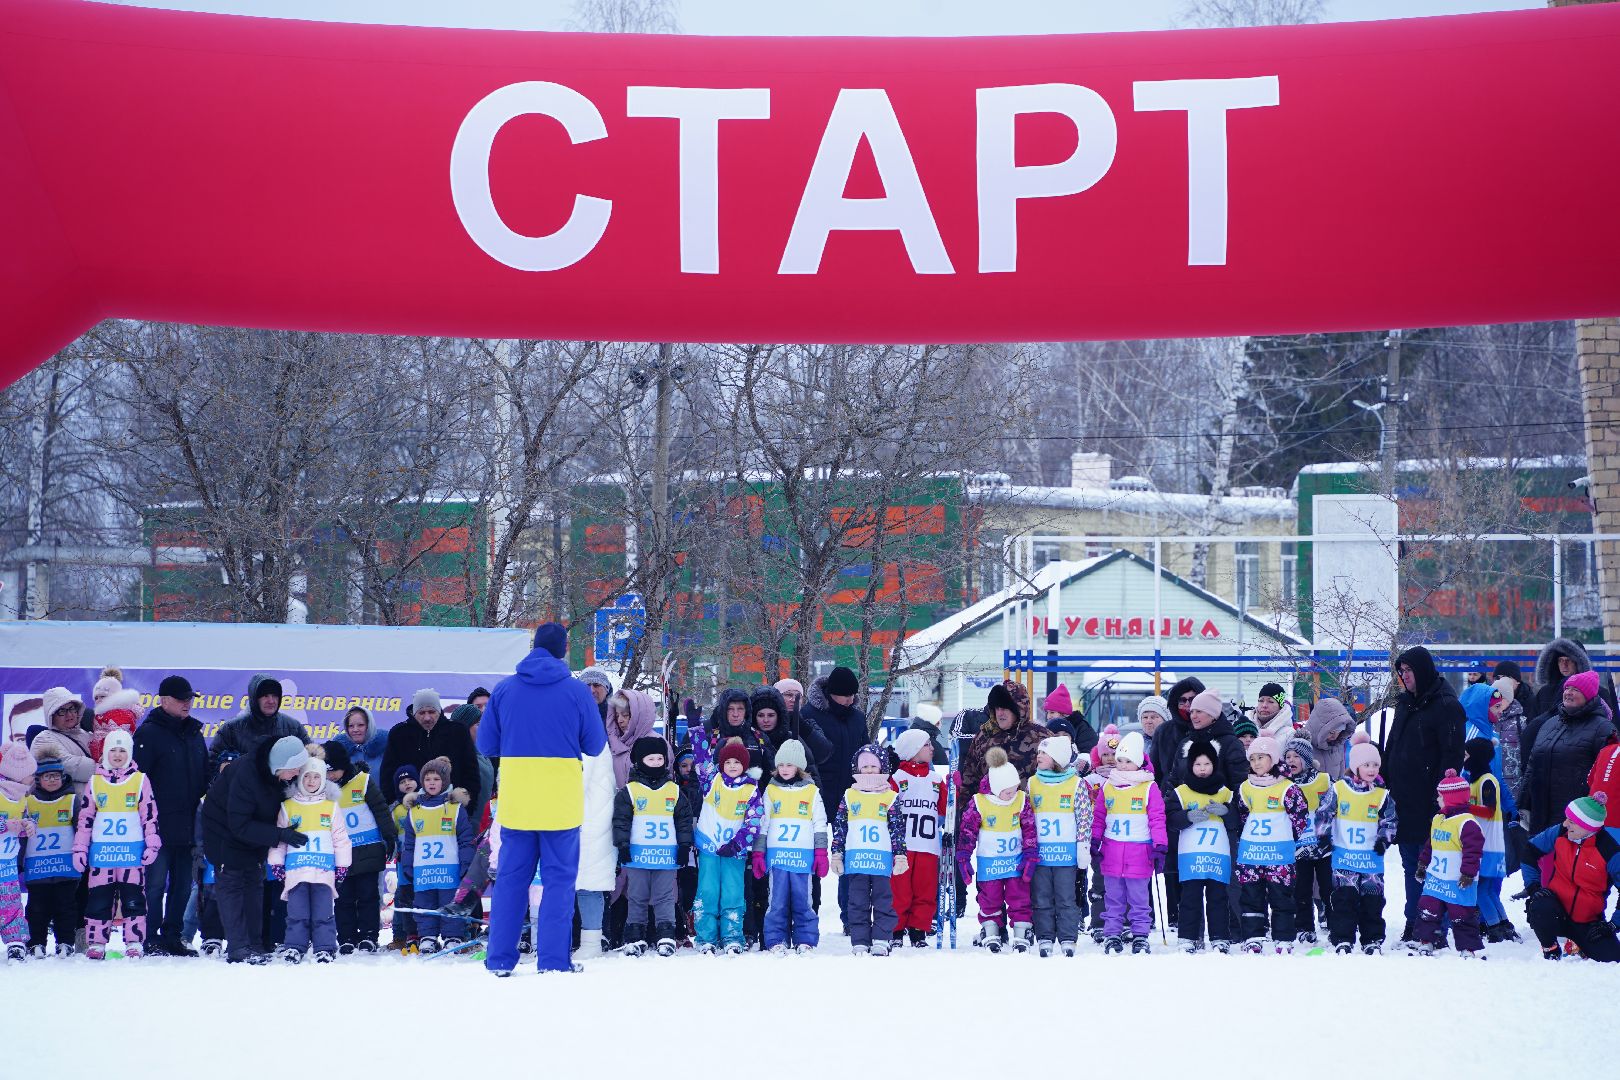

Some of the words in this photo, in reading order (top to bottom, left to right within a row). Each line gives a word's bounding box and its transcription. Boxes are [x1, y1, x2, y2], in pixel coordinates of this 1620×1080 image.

[450, 75, 1279, 274] СТАРТ
[103, 819, 127, 836] 26
[644, 821, 670, 840] 35
[1039, 818, 1060, 837] 31
[1111, 819, 1131, 836] 41
[1250, 818, 1272, 836] 25
[777, 824, 801, 842] 27
[860, 824, 880, 843] 16
[1196, 827, 1219, 846] 77
[1347, 827, 1366, 844] 15
[36, 833, 61, 851] 22
[996, 837, 1018, 854] 30
[100, 845, 130, 854] ДЮСШ
[422, 841, 445, 860] 32
[641, 848, 671, 857] ДЮСШ
[1039, 845, 1067, 853] ДЮСШ
[1248, 844, 1276, 853] ДЮСШ
[94, 853, 137, 863] РОШАЛЬ
[297, 854, 326, 863] ДЮСШ
[634, 855, 676, 865] РОШАЛЬ
[775, 851, 802, 859] ДЮСШ
[854, 852, 882, 861] ДЮСШ
[1195, 855, 1222, 864] ДЮСШ
[1242, 851, 1284, 861] РОШАЛЬ
[1343, 852, 1371, 861] ДЮСШ
[35, 857, 64, 867] ДЮСШ
[850, 860, 886, 870] РОШАЛЬ
[1338, 857, 1377, 869] РОШАЛЬ
[1431, 855, 1448, 874] 21
[29, 864, 72, 874] РОШАЛЬ
[421, 867, 448, 877] ДЮСШ
[1190, 864, 1223, 875] РОШАЛЬ
[416, 875, 453, 885] РОШАЛЬ
